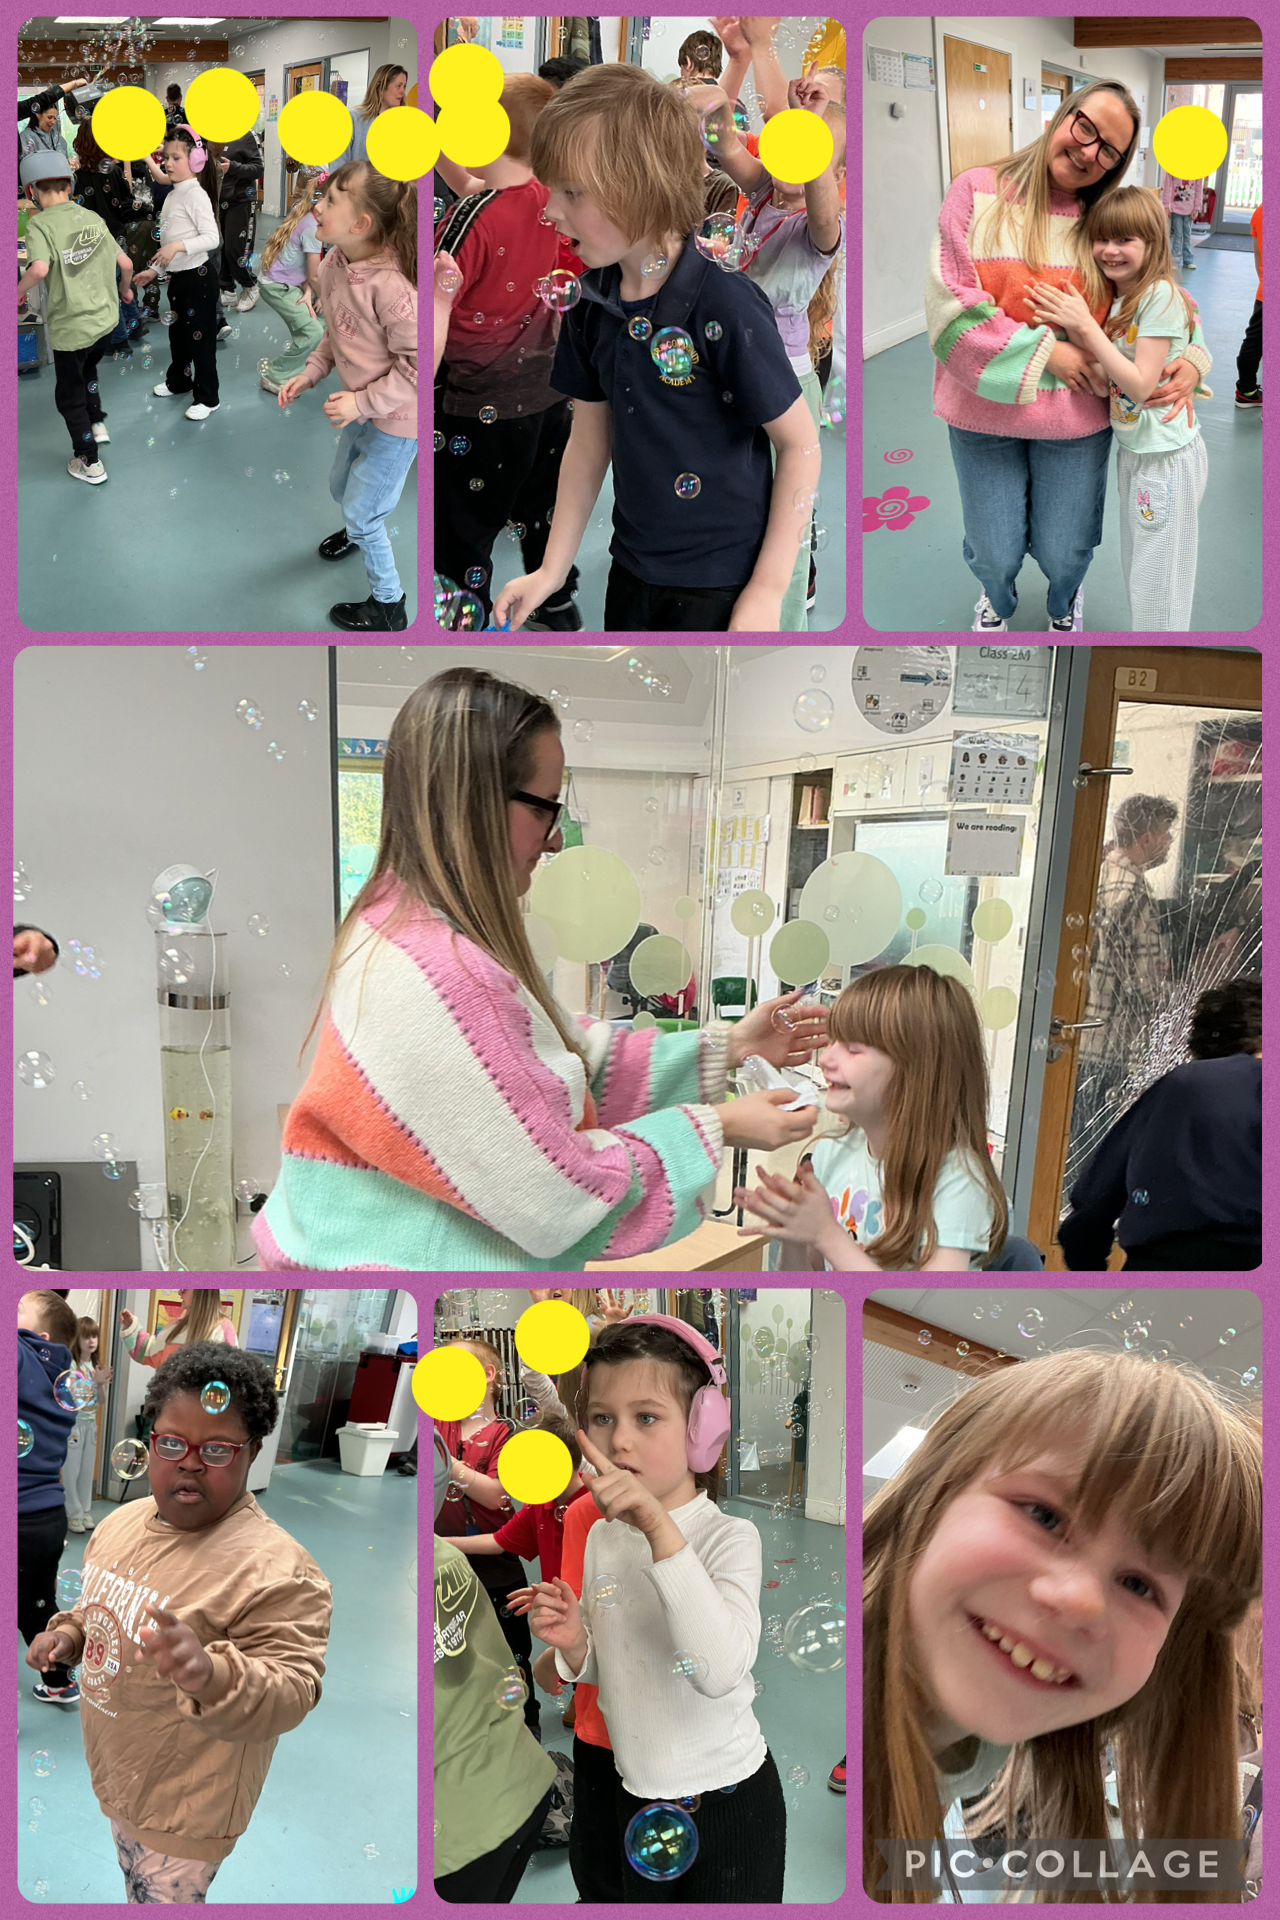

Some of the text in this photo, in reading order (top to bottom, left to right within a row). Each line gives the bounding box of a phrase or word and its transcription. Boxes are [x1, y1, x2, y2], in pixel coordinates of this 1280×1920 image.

[659, 374, 696, 387] ACADEMY
[979, 646, 1008, 660] Class
[1128, 670, 1148, 687] B2
[1016, 672, 1032, 704] 4
[956, 822, 1018, 834] We are reading:
[92, 1610, 119, 1656] ANGELES
[85, 1637, 106, 1666] 89
[106, 1658, 119, 1673] USA
[87, 1673, 107, 1688] COAST
